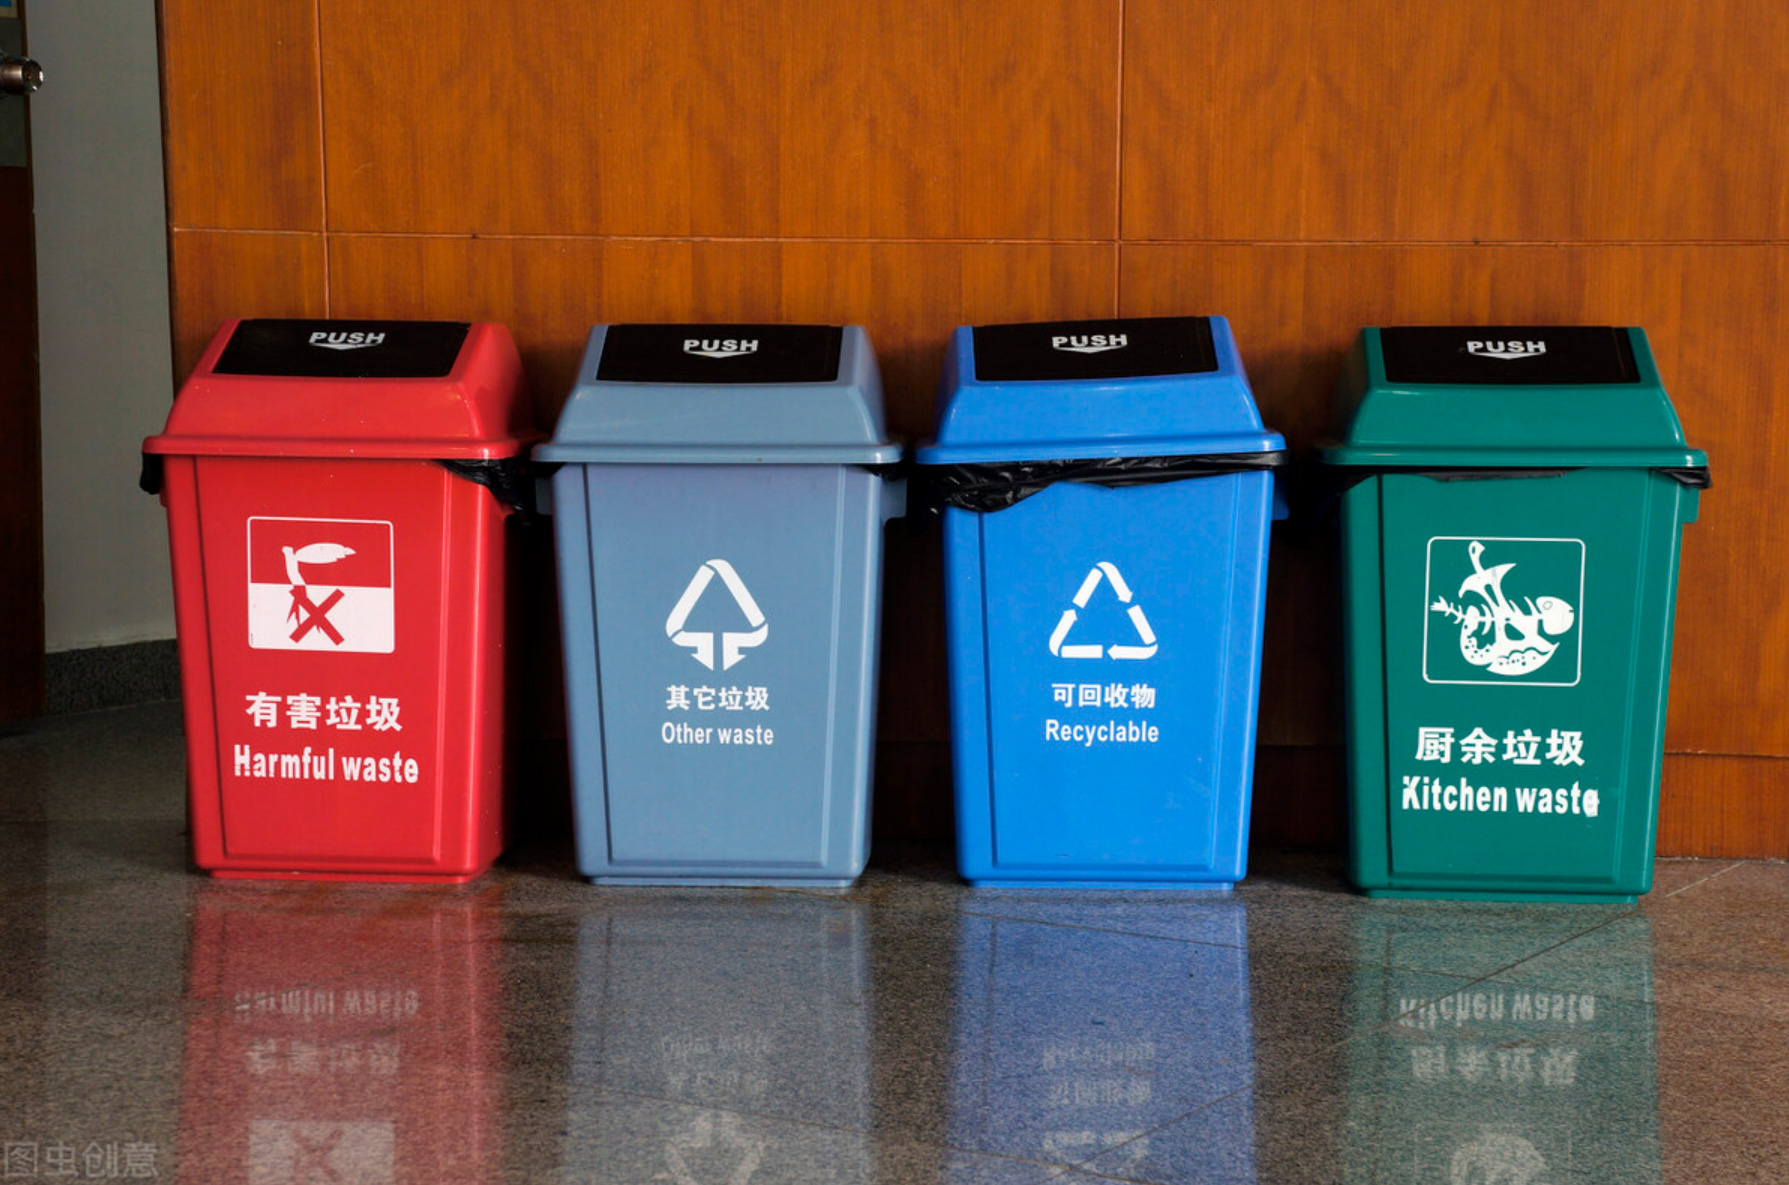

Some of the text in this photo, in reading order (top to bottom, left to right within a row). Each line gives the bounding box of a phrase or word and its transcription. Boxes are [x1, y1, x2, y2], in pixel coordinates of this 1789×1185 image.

[309, 332, 386, 344] PUSH
[683, 339, 759, 352] PUSH
[1052, 334, 1128, 348] PUSH
[1466, 341, 1547, 354] PUSH
[665, 684, 770, 711] 其它垃圾
[1051, 682, 1157, 710] 可回收物
[245, 691, 403, 732] 有害垃圾
[661, 721, 774, 746] Other waste
[1045, 718, 1159, 748] Recyclable
[1414, 726, 1585, 767] 厨余垃圾
[233, 743, 419, 784] Harmful waste
[1402, 775, 1508, 812] Kitchen
